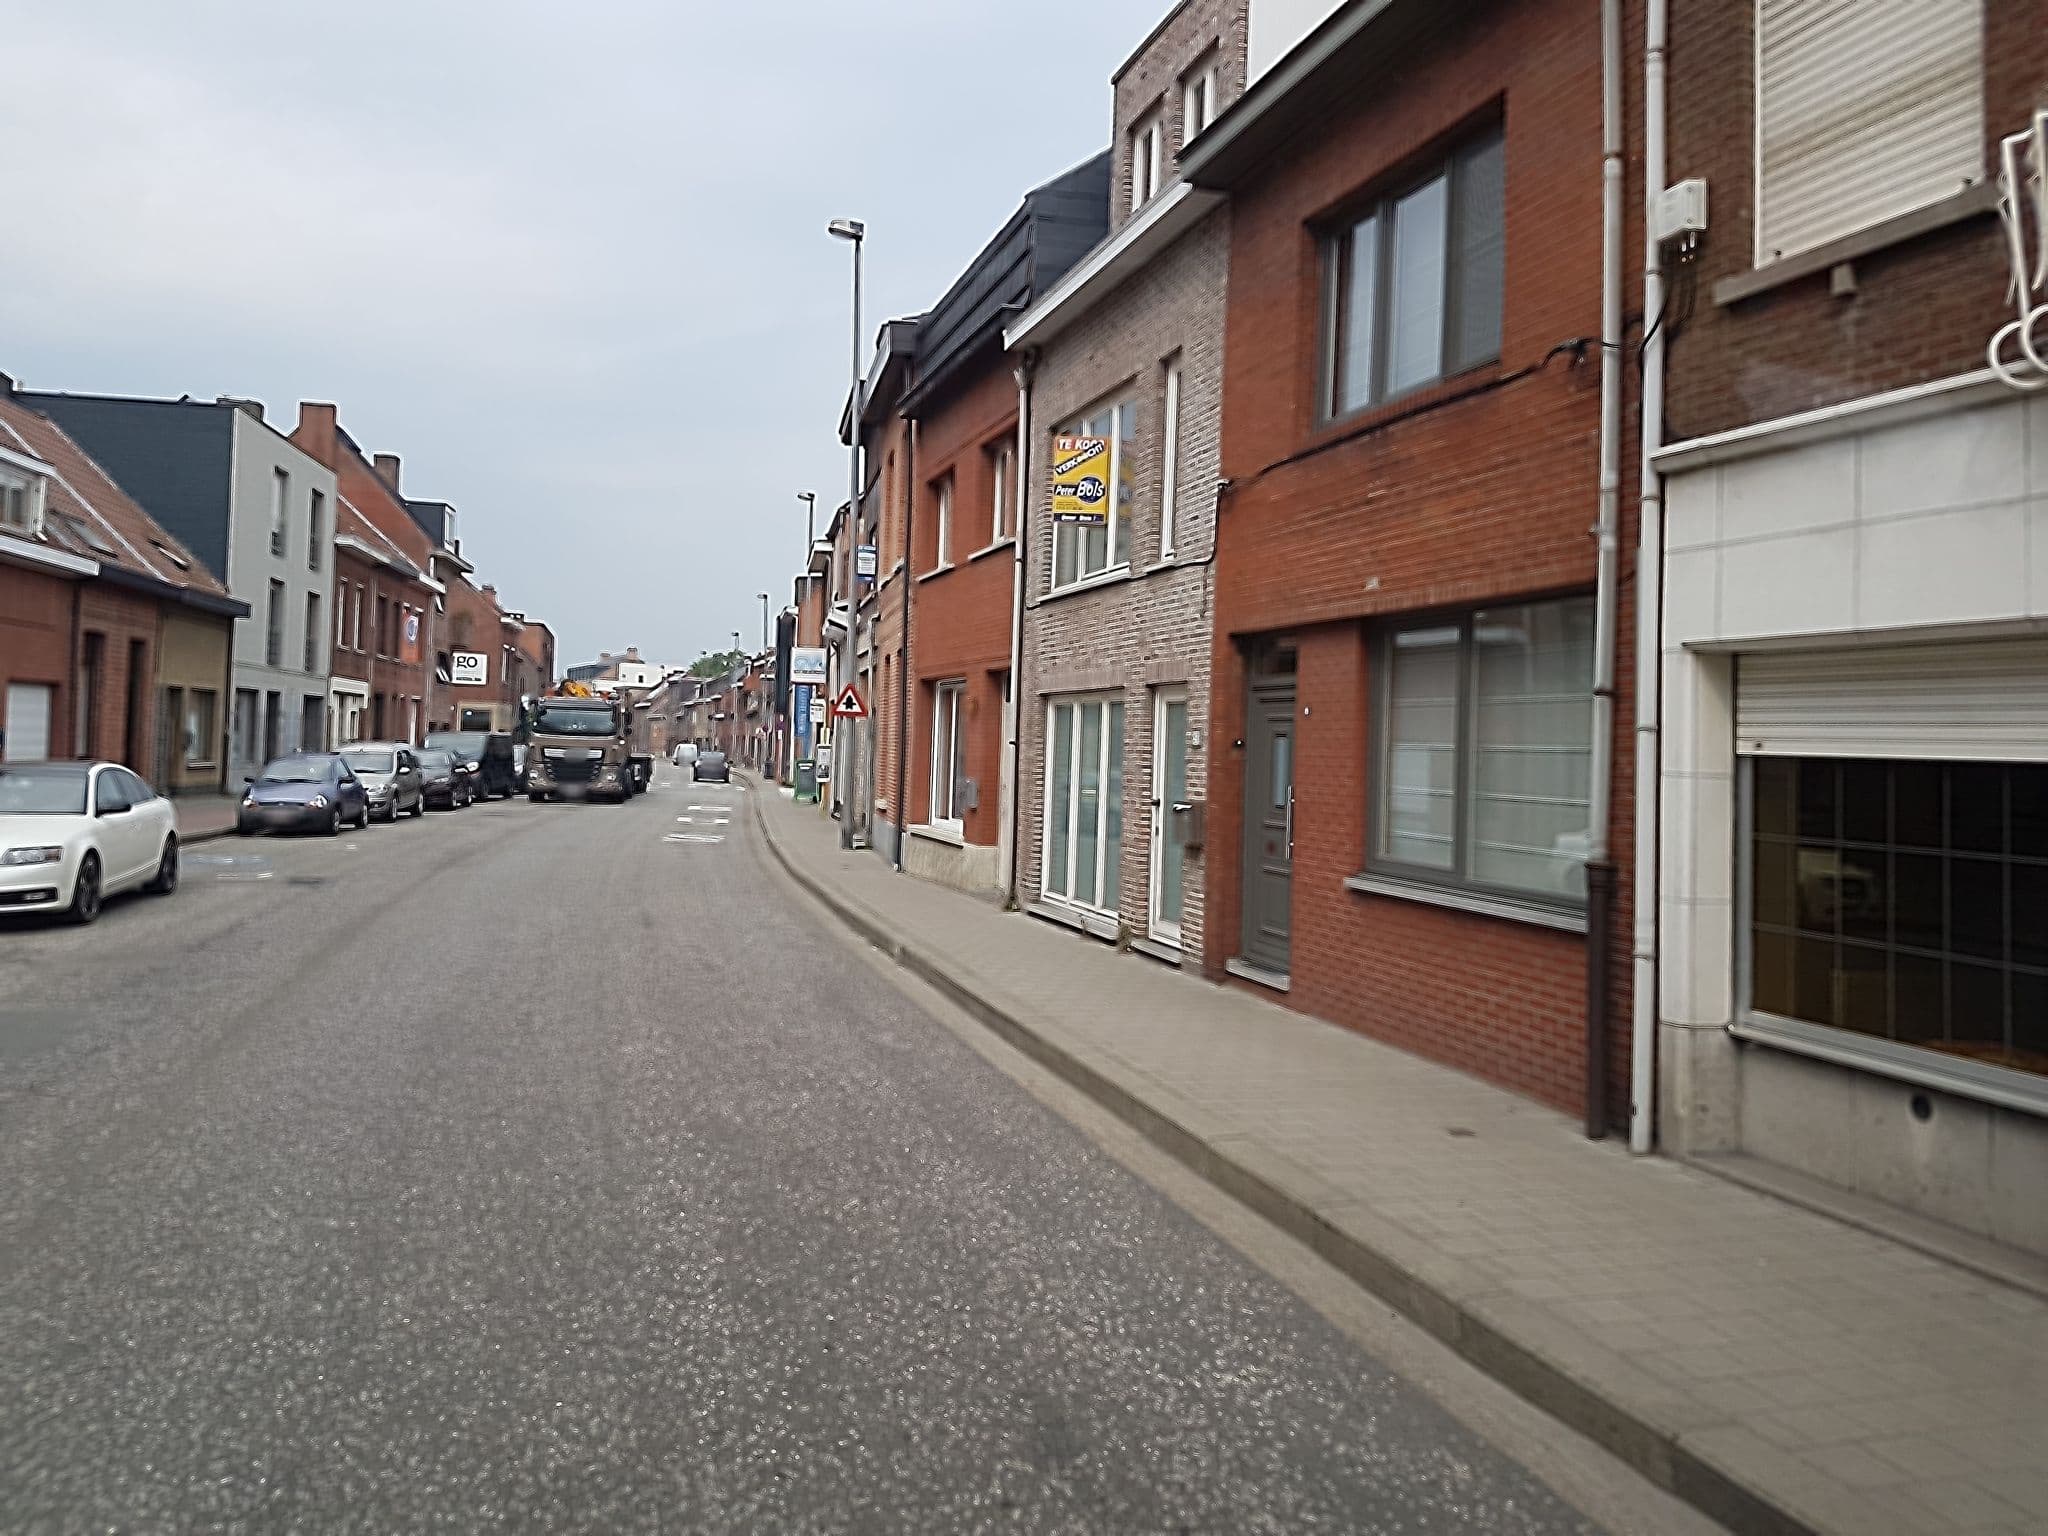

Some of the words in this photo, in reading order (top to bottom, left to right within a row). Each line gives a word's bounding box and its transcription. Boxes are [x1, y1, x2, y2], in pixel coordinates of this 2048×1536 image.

[1059, 439, 1072, 449] TE
[1077, 481, 1105, 497] Bols
[456, 656, 478, 669] go
